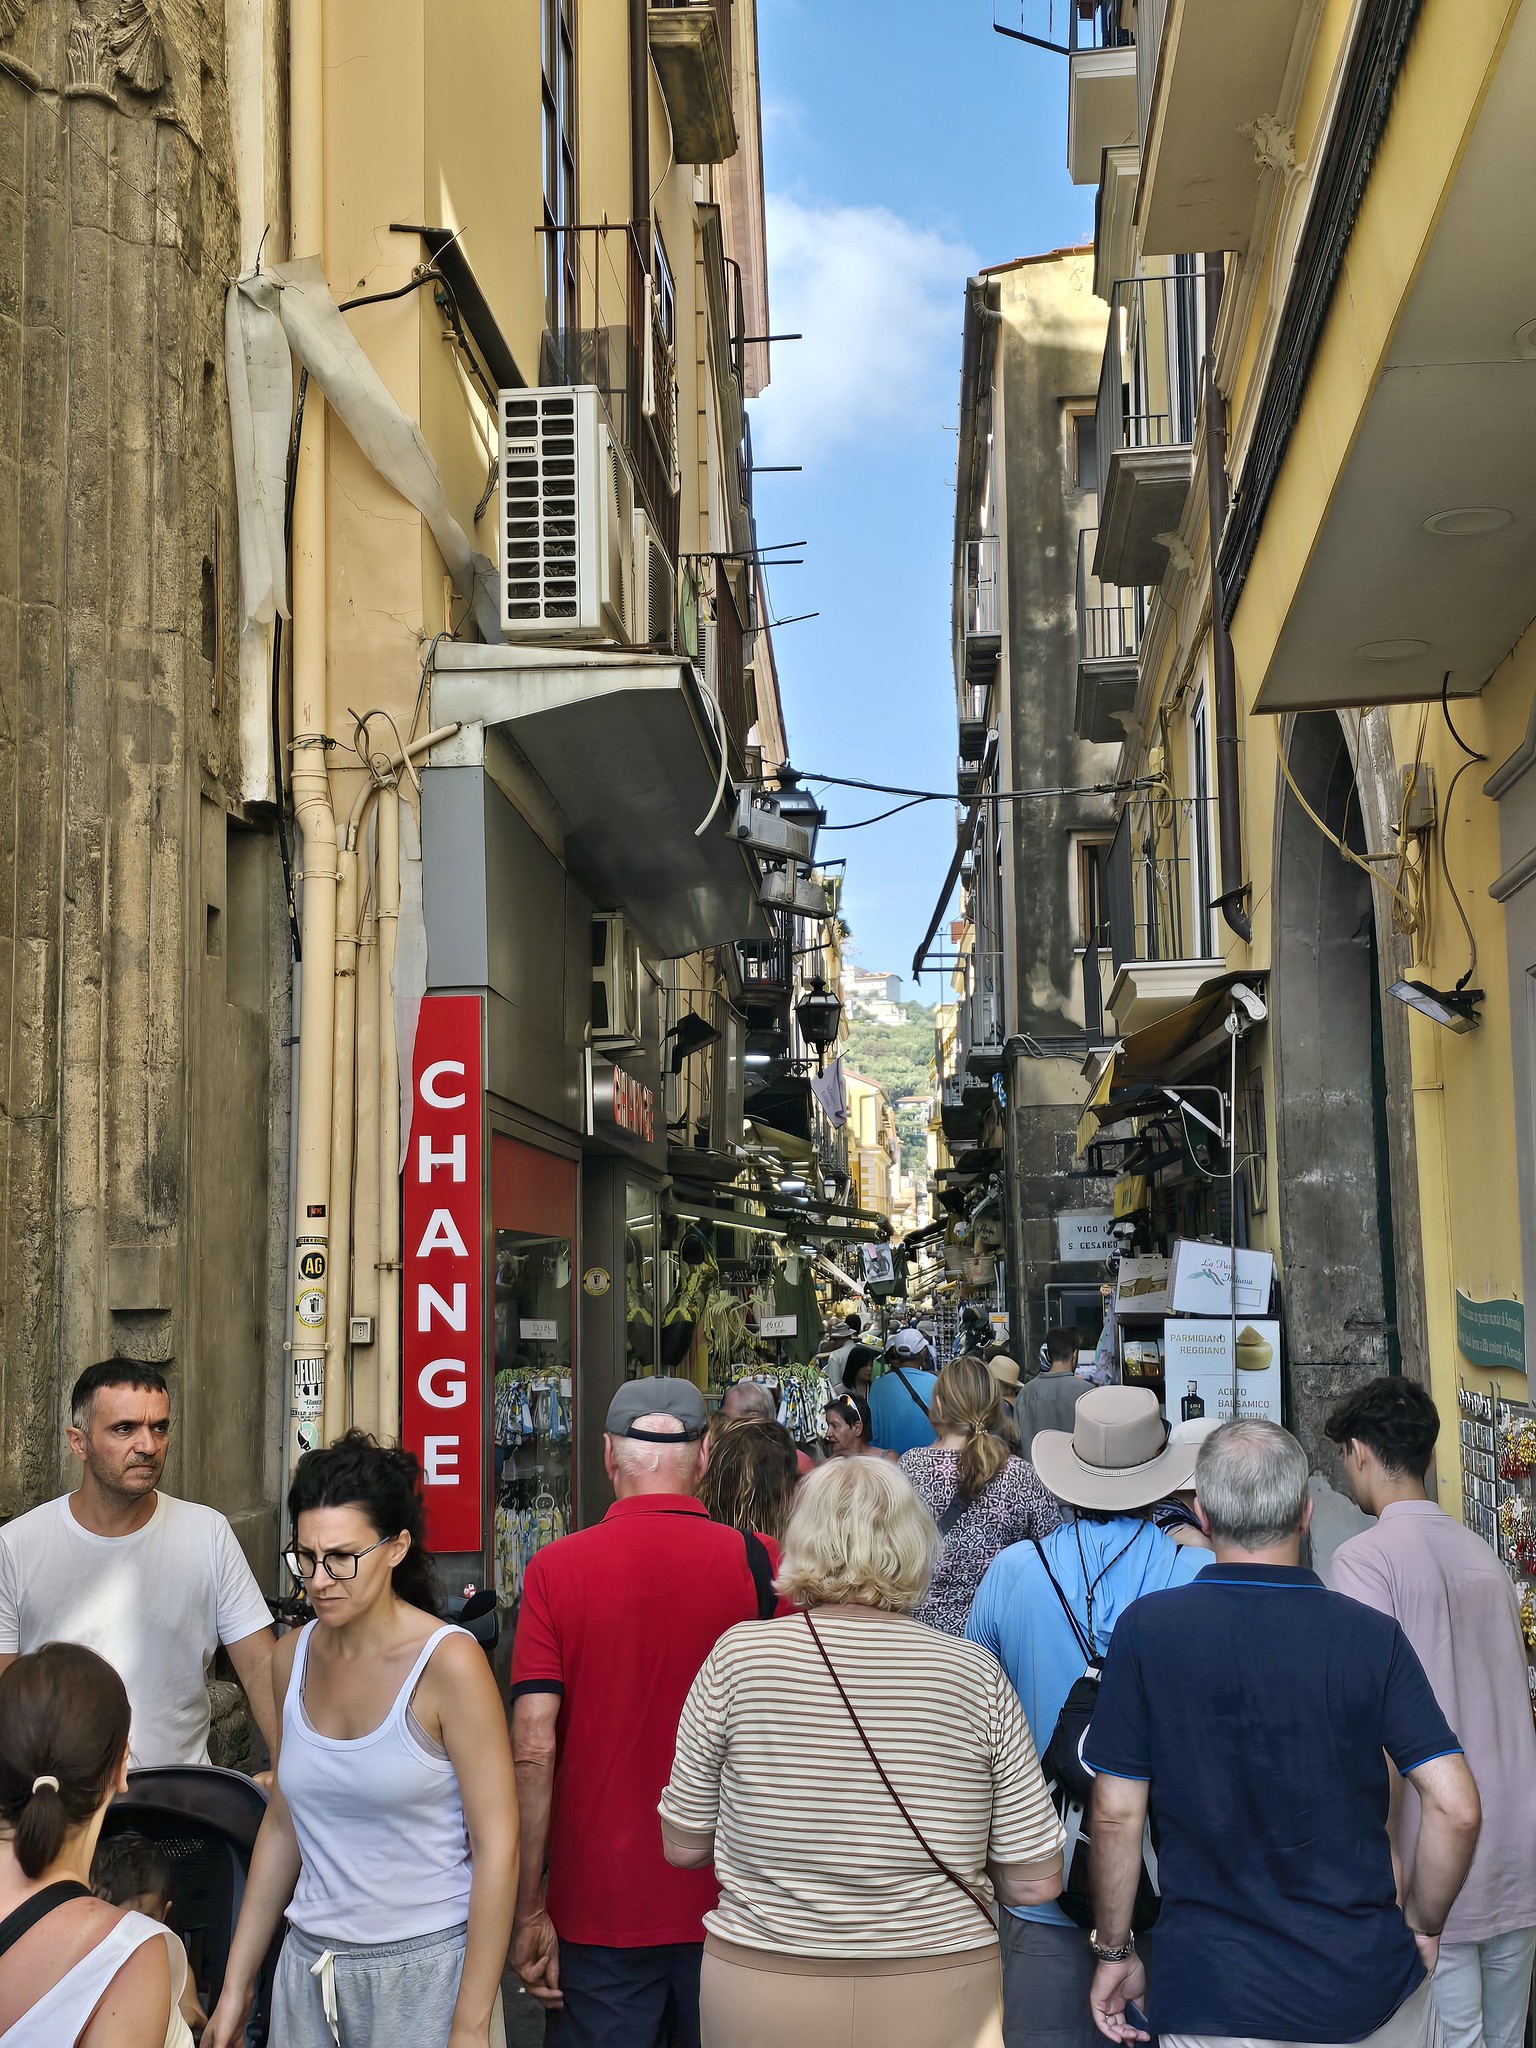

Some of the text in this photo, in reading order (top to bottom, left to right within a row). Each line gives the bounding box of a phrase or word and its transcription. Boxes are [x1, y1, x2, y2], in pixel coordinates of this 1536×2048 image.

[612, 1064, 654, 1143] CHANGE
[1077, 1225, 1098, 1233] VICO
[1068, 1240, 1118, 1250] S. CESAREO
[305, 1257, 323, 1274] AG
[1201, 1258, 1214, 1267] La
[416, 1060, 470, 1486] CHANGE
[1170, 1334, 1226, 1343] PARMIGIANO
[1180, 1346, 1226, 1355] REGGIANO
[1217, 1388, 1247, 1396] ACETO
[1218, 1400, 1270, 1409] BALSAMICO
[1218, 1411, 1227, 1420] DI
